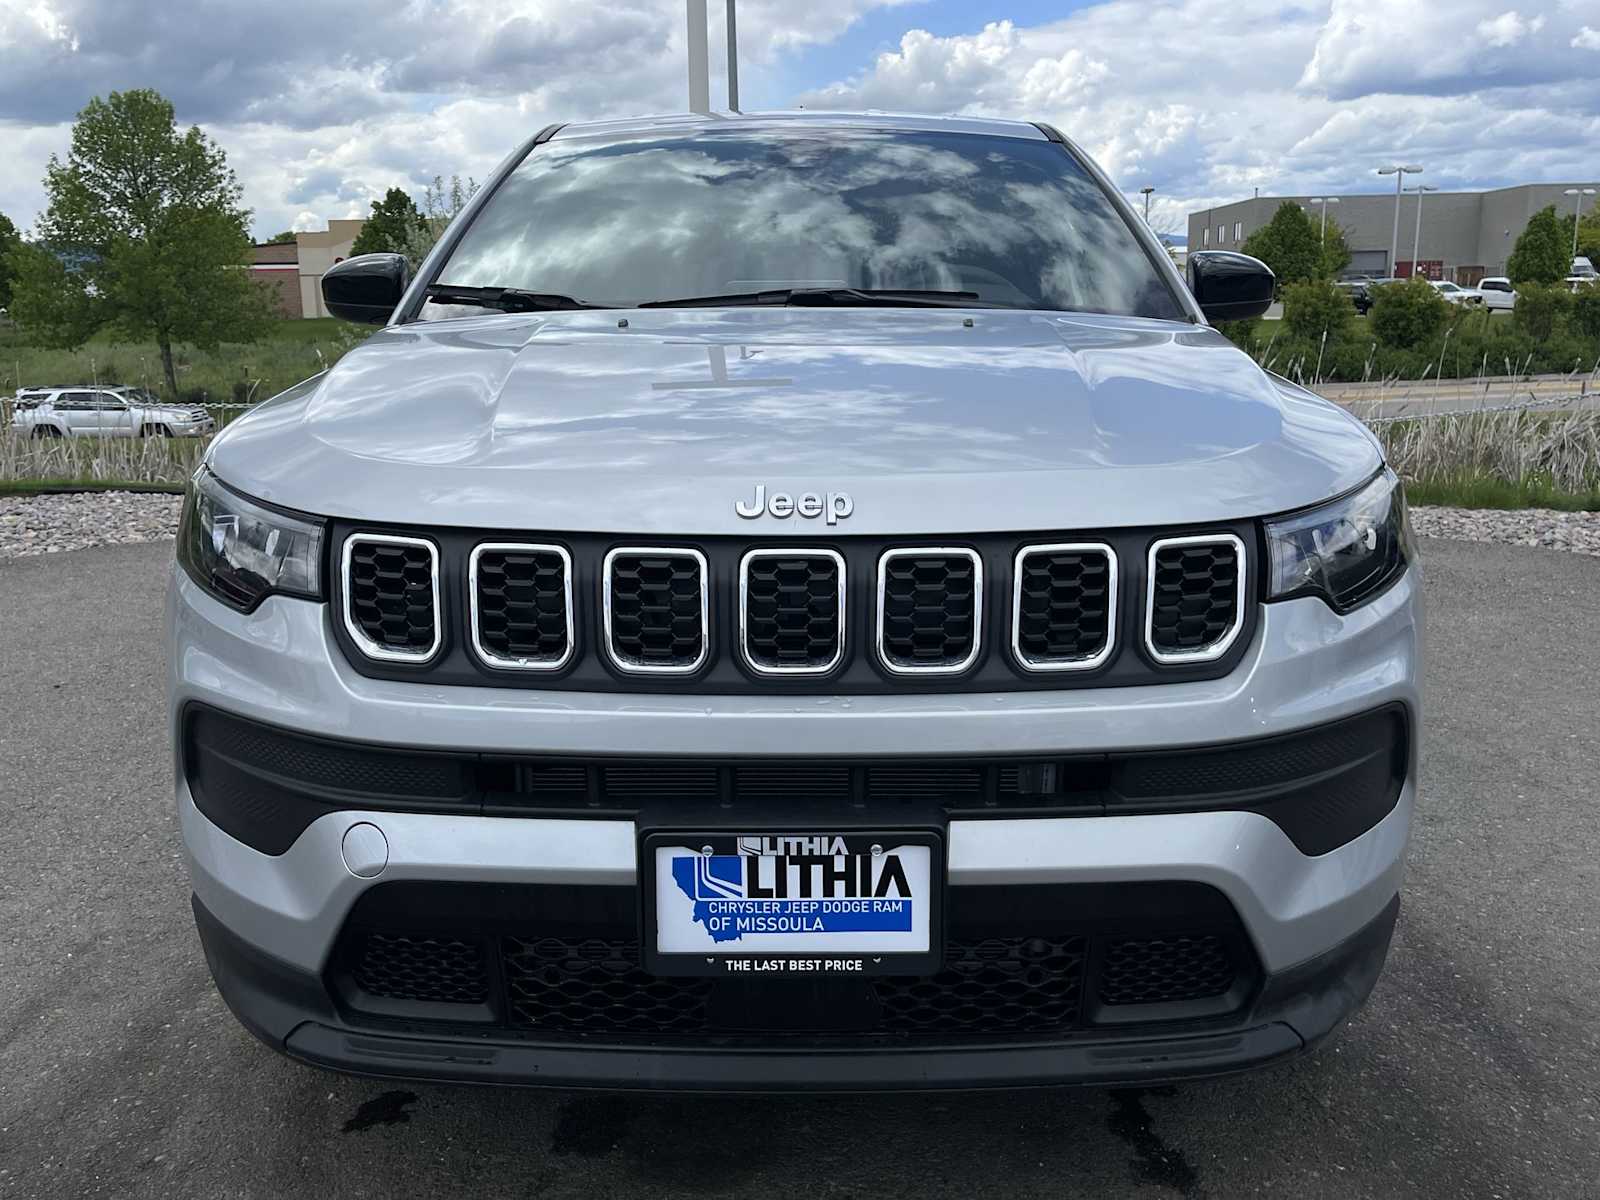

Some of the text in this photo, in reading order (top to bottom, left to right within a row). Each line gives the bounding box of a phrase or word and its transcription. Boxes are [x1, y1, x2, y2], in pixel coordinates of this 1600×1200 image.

[735, 485, 854, 526] Jeep
[762, 836, 849, 856] LITHIA
[747, 855, 912, 899] LITHIA
[709, 900, 903, 914] CHRYSLER JEEP DODGE RAM
[709, 917, 824, 931] OF MISSOULA
[725, 960, 863, 971] THE LAST BEST PRICE
